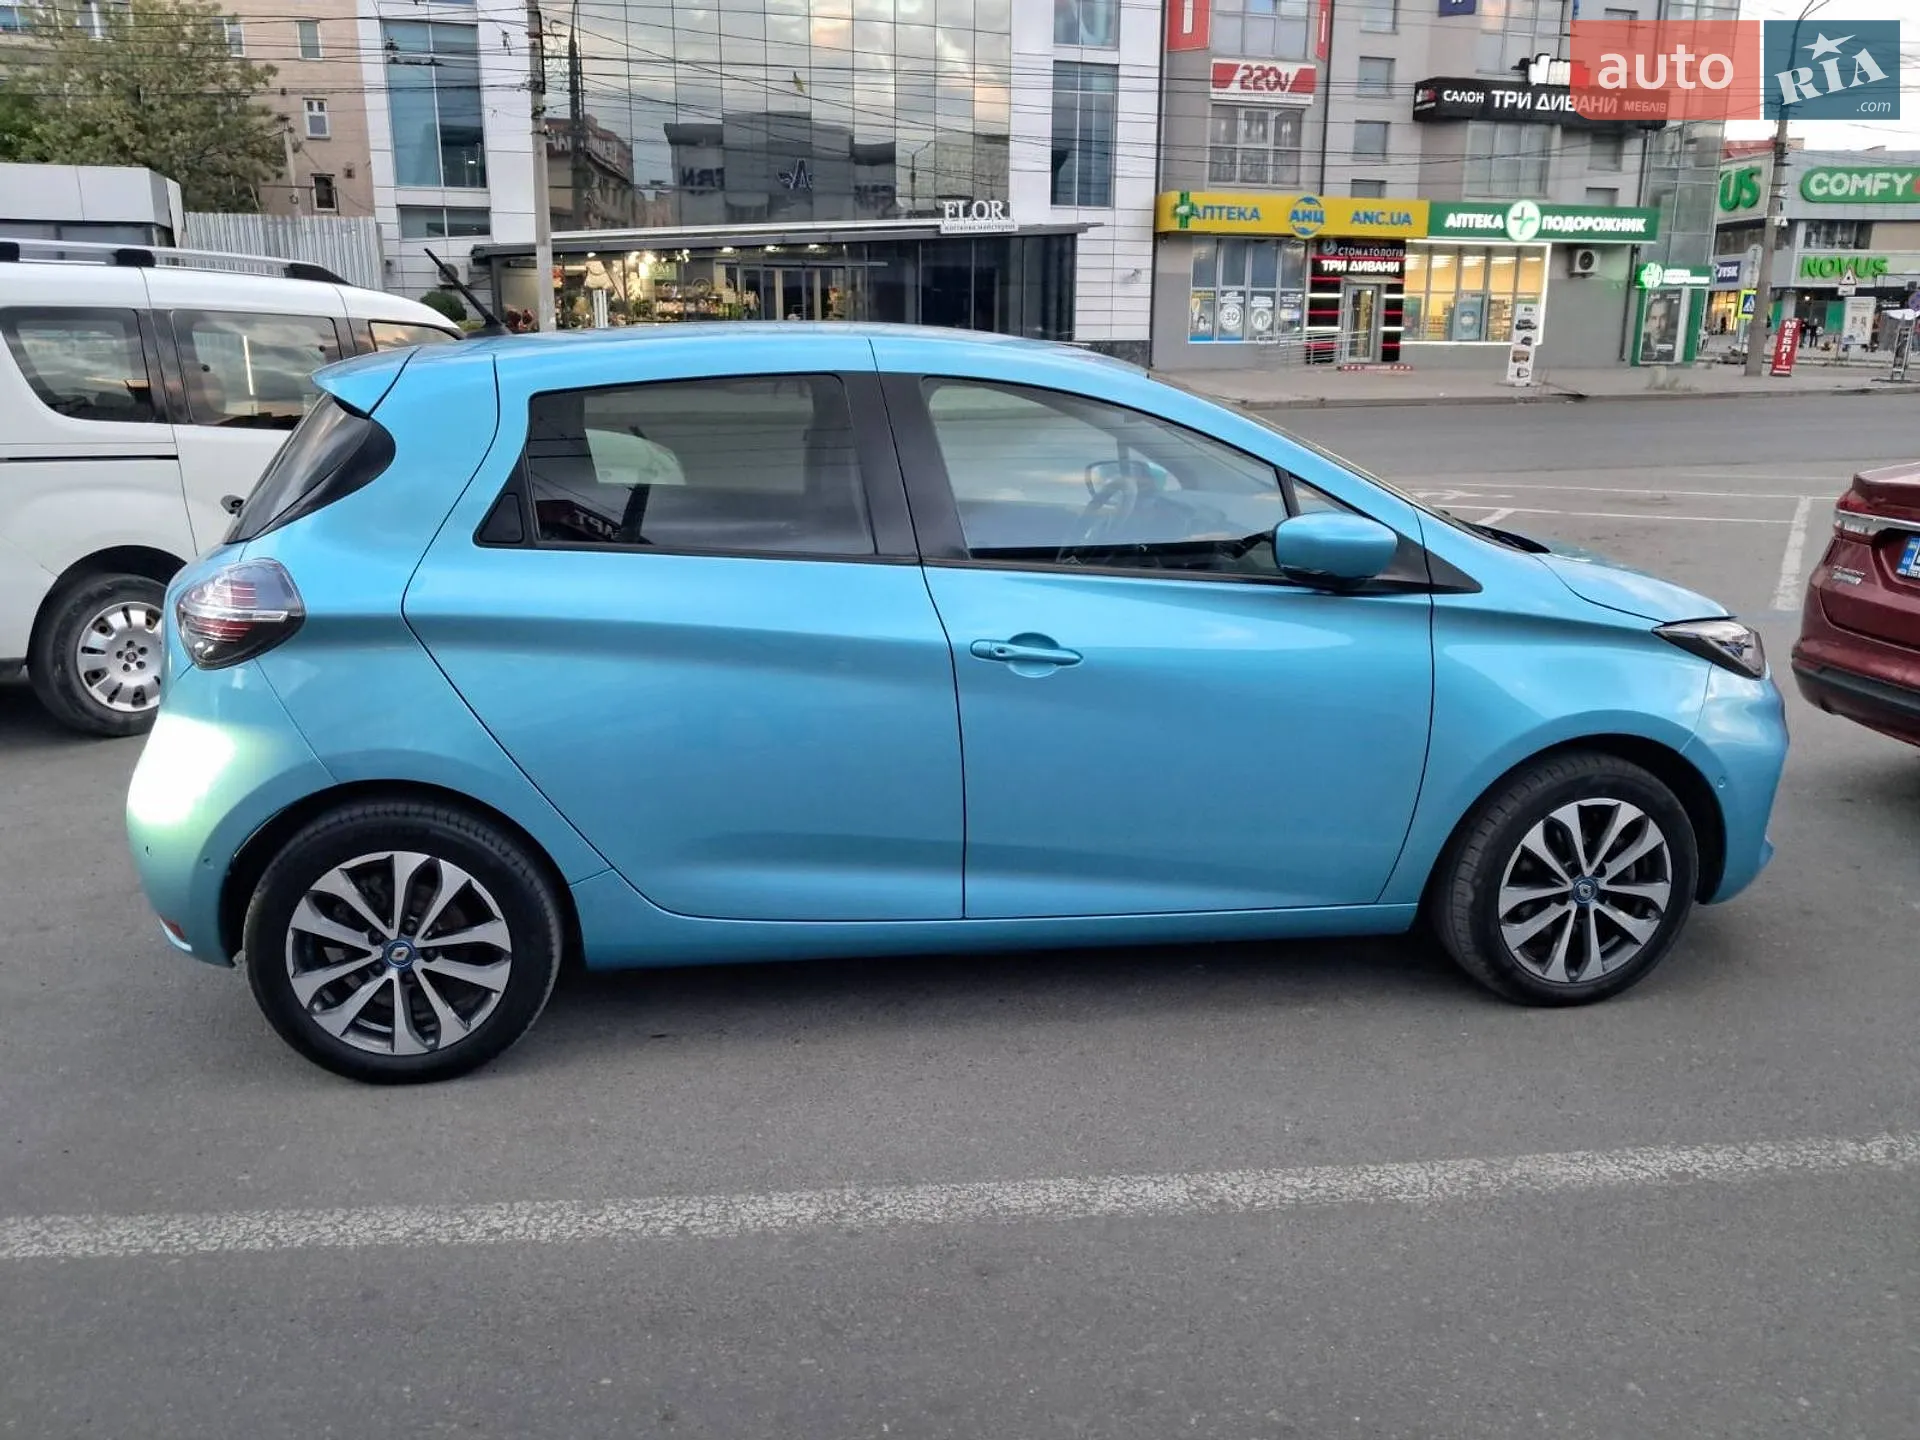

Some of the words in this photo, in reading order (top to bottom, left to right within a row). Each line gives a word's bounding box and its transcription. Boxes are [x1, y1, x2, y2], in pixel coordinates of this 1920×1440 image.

[1443, 89, 1485, 103] САЛОН
[1491, 89, 1532, 109] ТРИ
[1535, 92, 1618, 114] ДИВАНИ
[1624, 101, 1667, 113] МЕБЛІВ
[1809, 172, 1912, 197] COMFY
[1191, 205, 1260, 221] АПТЕКА
[1289, 209, 1325, 225] АНЦ
[1351, 211, 1412, 226] ANC.UA
[1445, 212, 1504, 229] АПТЕКА
[1542, 215, 1646, 233] ПОДОРОЖНИК
[1338, 246, 1404, 257] СТОМАТОЛОГІЯ
[1321, 260, 1347, 272] ТРИ
[1349, 261, 1400, 273] ДИВАНИ
[1801, 256, 1890, 279] NOVUS
